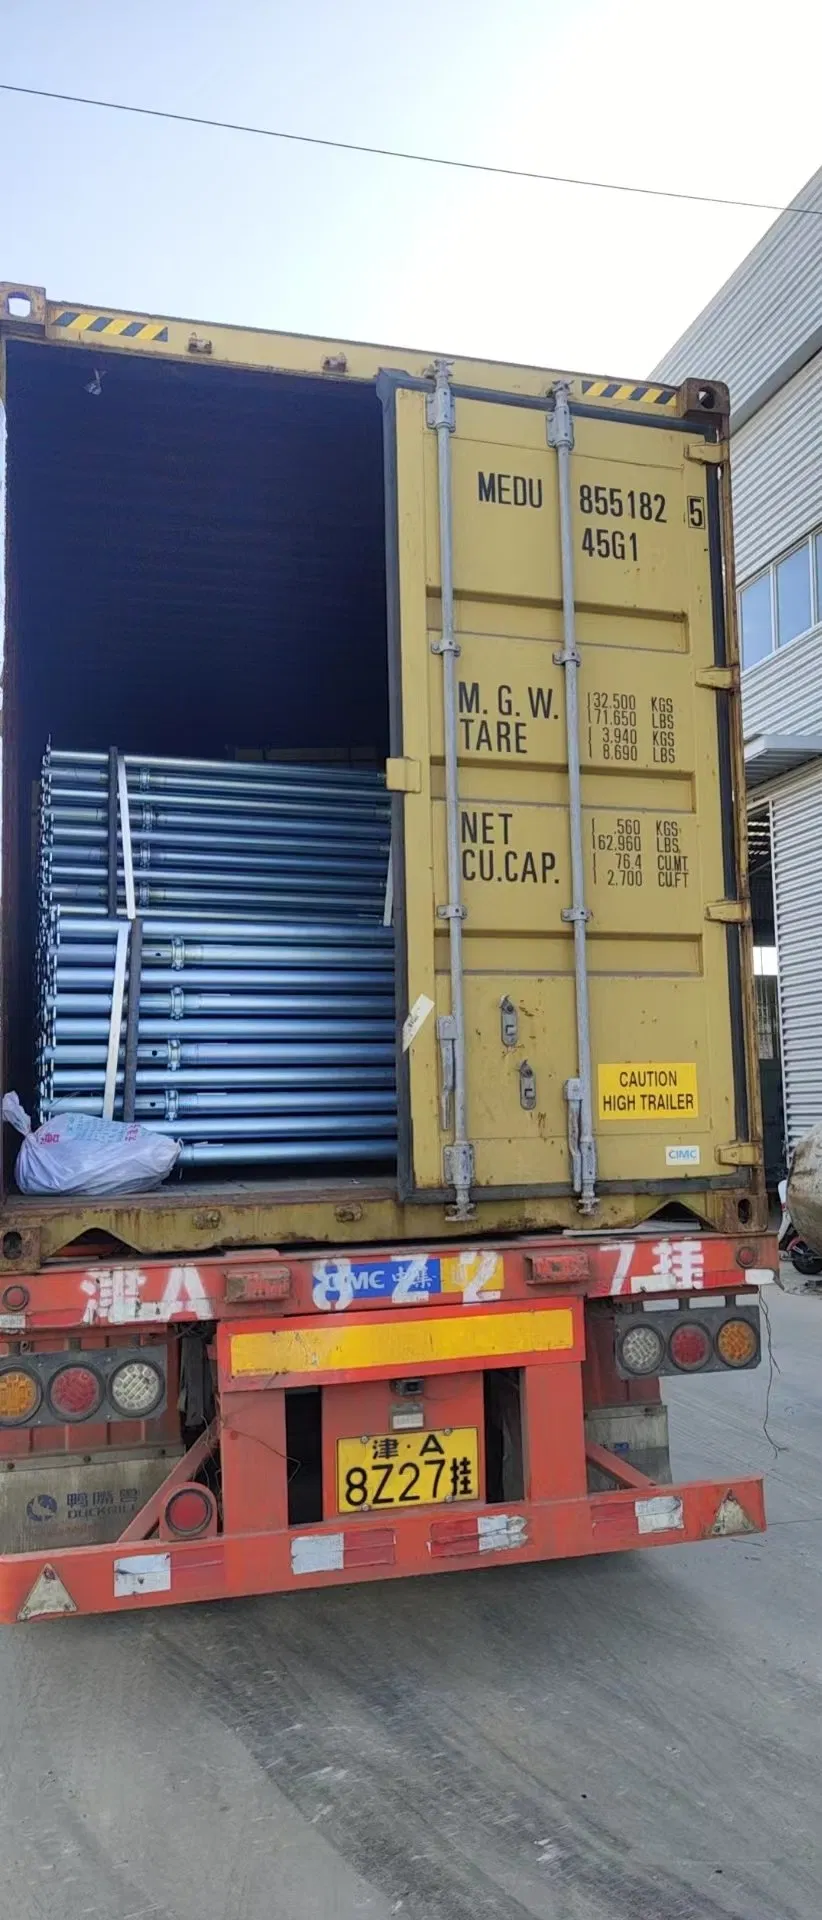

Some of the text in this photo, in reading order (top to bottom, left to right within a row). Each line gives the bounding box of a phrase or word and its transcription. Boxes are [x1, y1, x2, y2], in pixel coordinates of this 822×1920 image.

[477, 471, 703, 527] MEDU 855182 5
[582, 528, 638, 562] 45G1
[593, 692, 674, 714] 32.500 KGS
[594, 708, 674, 730] 71.650 LBS
[460, 718, 528, 754] TARE
[602, 727, 675, 747] 3.940 KGS
[603, 743, 676, 764] 8.690 LBS
[461, 811, 513, 845] NET
[598, 834, 642, 852] 62.960
[462, 849, 560, 884] CU.CAP.
[615, 853, 642, 870] 76.4
[607, 869, 643, 887] 2.700
[619, 1070, 678, 1088] CAUTION
[603, 1093, 694, 1112] HIGH TRAILER
[668, 1149, 698, 1160] CIMC
